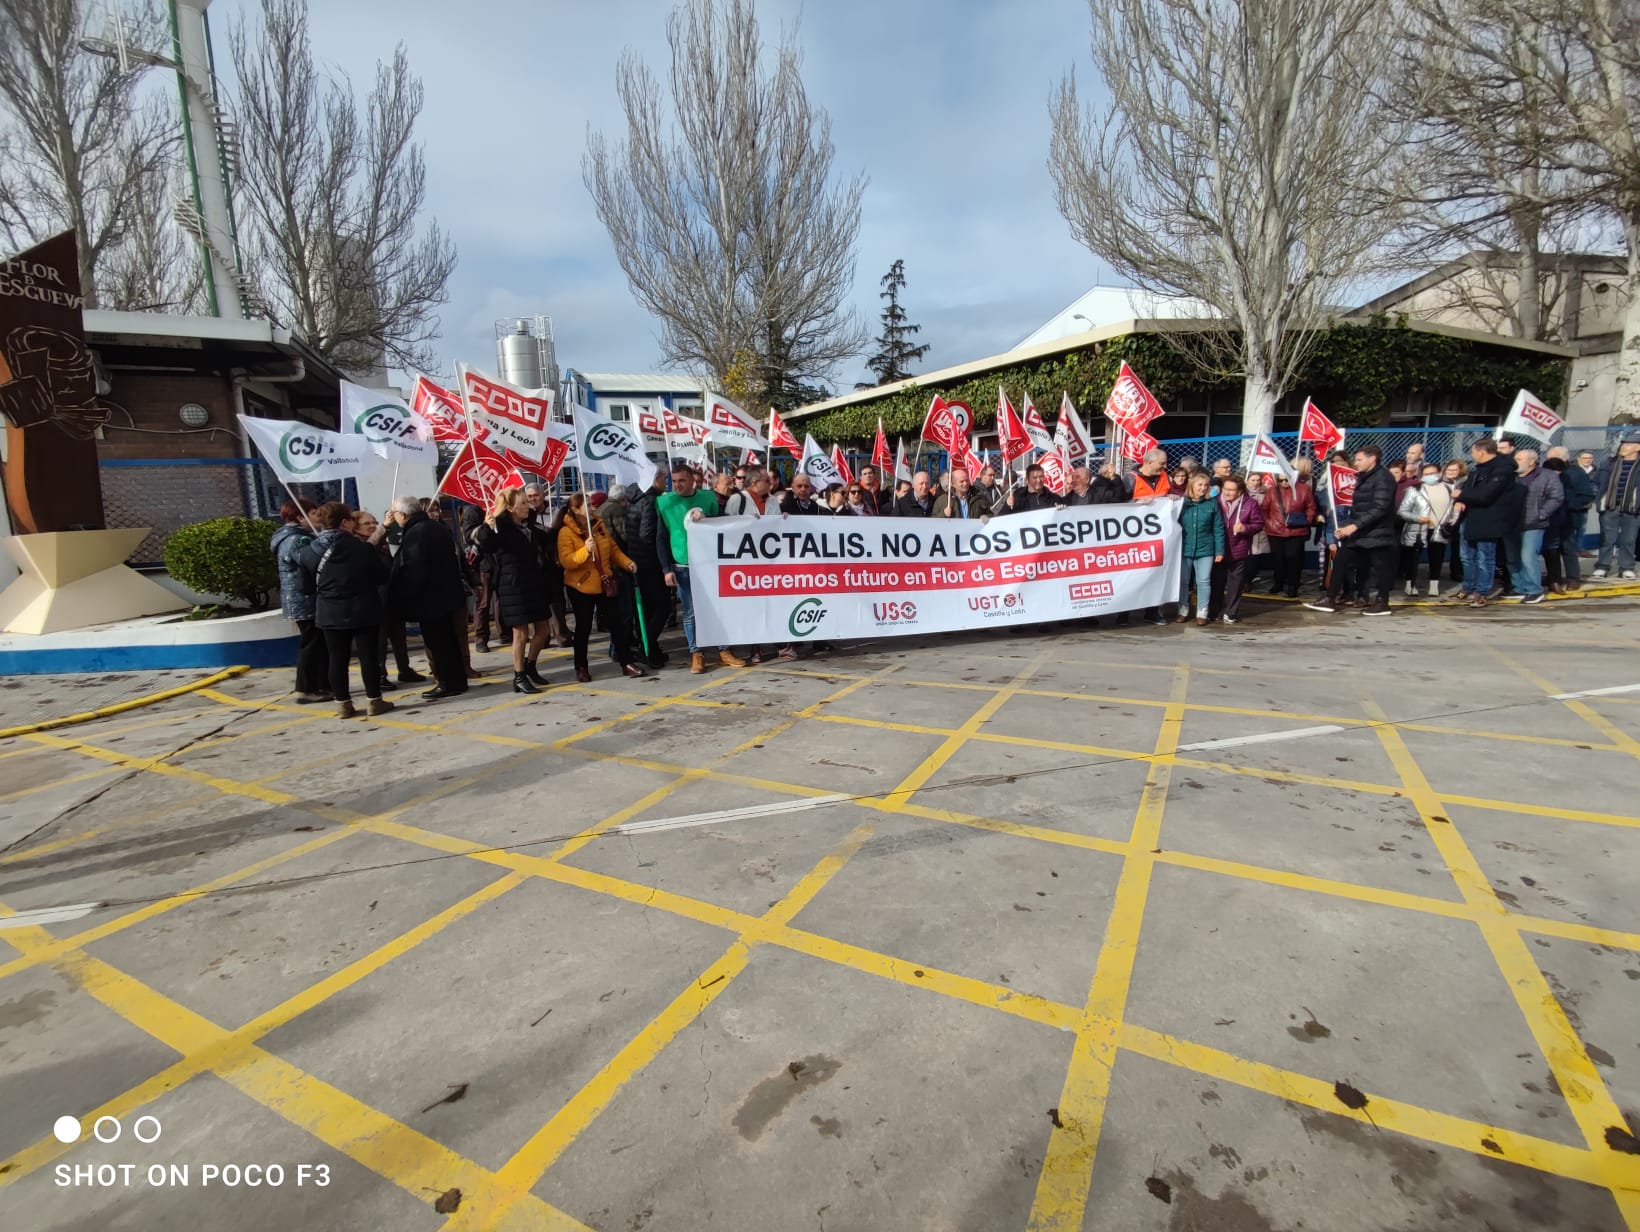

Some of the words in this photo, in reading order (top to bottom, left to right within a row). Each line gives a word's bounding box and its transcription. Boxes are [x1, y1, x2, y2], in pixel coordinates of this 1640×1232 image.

[7, 260, 65, 286] FLOR
[468, 379, 542, 424] CCOO
[510, 430, 536, 447] León
[717, 532, 872, 559] LACTALIS.
[881, 533, 921, 558] NO
[929, 533, 947, 557] A
[955, 531, 1011, 557] LOS
[1019, 513, 1162, 550] DESPIDOS
[729, 570, 839, 591] Queremos
[843, 568, 899, 587] futuro
[904, 570, 927, 585] en
[931, 566, 965, 584] Flor
[971, 565, 995, 581] de
[1000, 558, 1079, 580] Esgueva
[1084, 546, 1156, 569] Peñafiel
[1071, 583, 1111, 597] CCOO
[872, 601, 917, 621] USO
[967, 595, 1000, 611] UGT
[796, 609, 827, 623] CSIF
